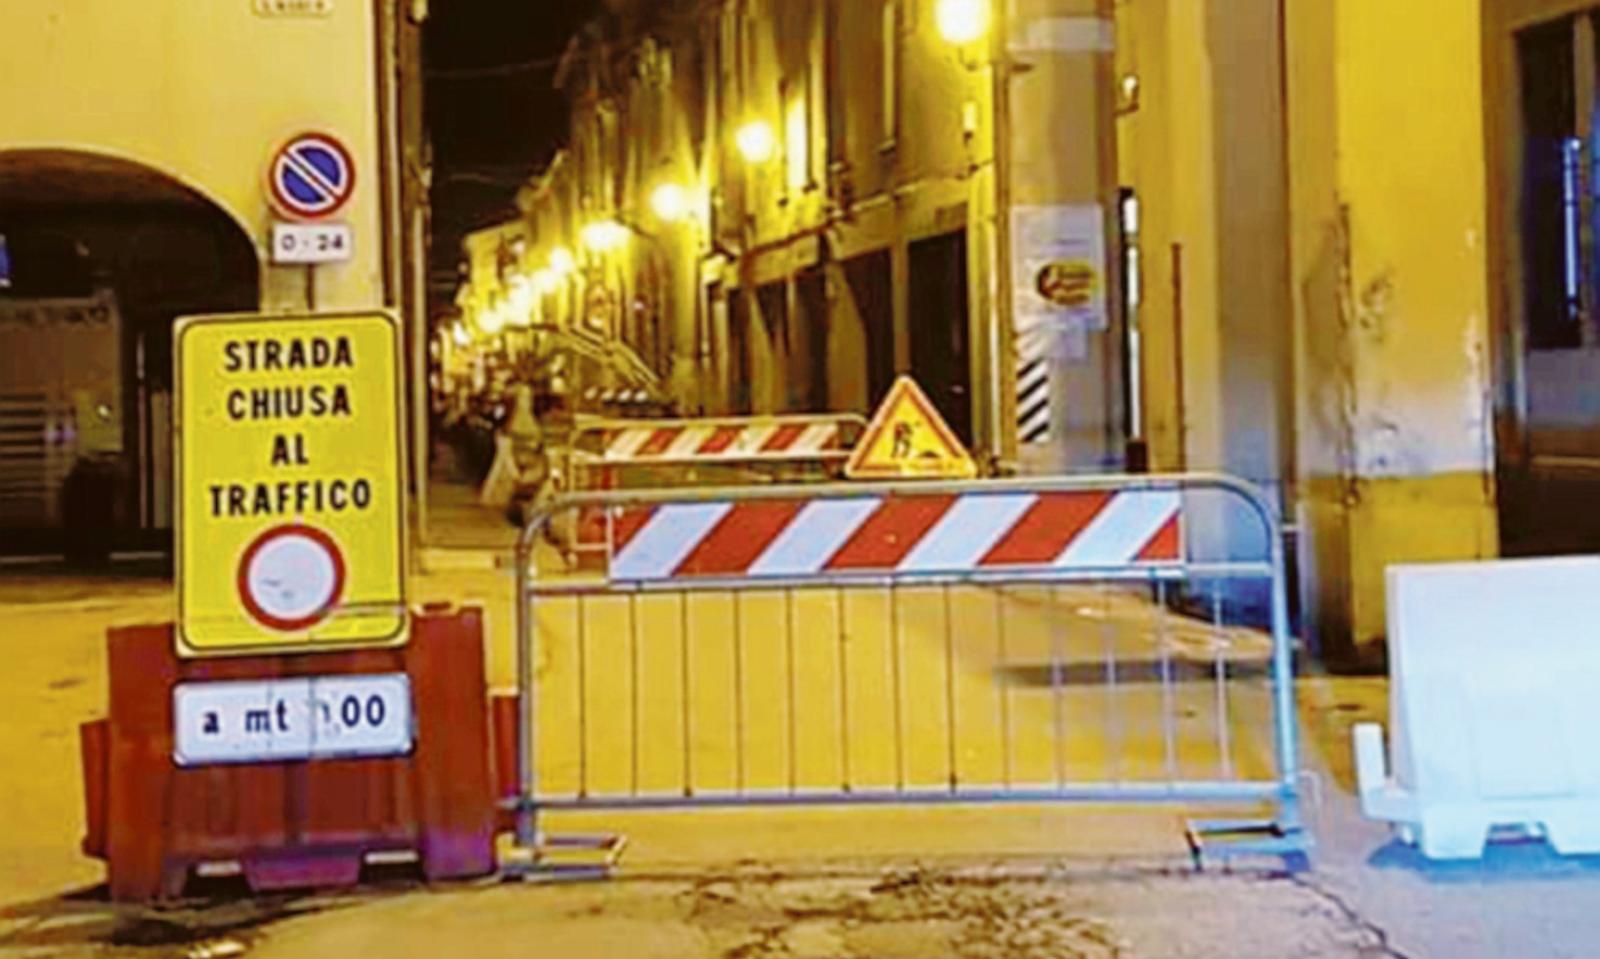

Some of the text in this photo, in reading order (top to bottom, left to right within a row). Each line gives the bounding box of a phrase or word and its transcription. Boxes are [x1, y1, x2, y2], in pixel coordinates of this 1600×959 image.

[317, 234, 343, 251] 24
[224, 337, 352, 372] STRADA
[227, 384, 351, 420] CHIUSA
[271, 434, 309, 466] AL
[209, 479, 371, 517] TRAFFICO
[203, 711, 219, 734] a
[245, 699, 288, 732] mt
